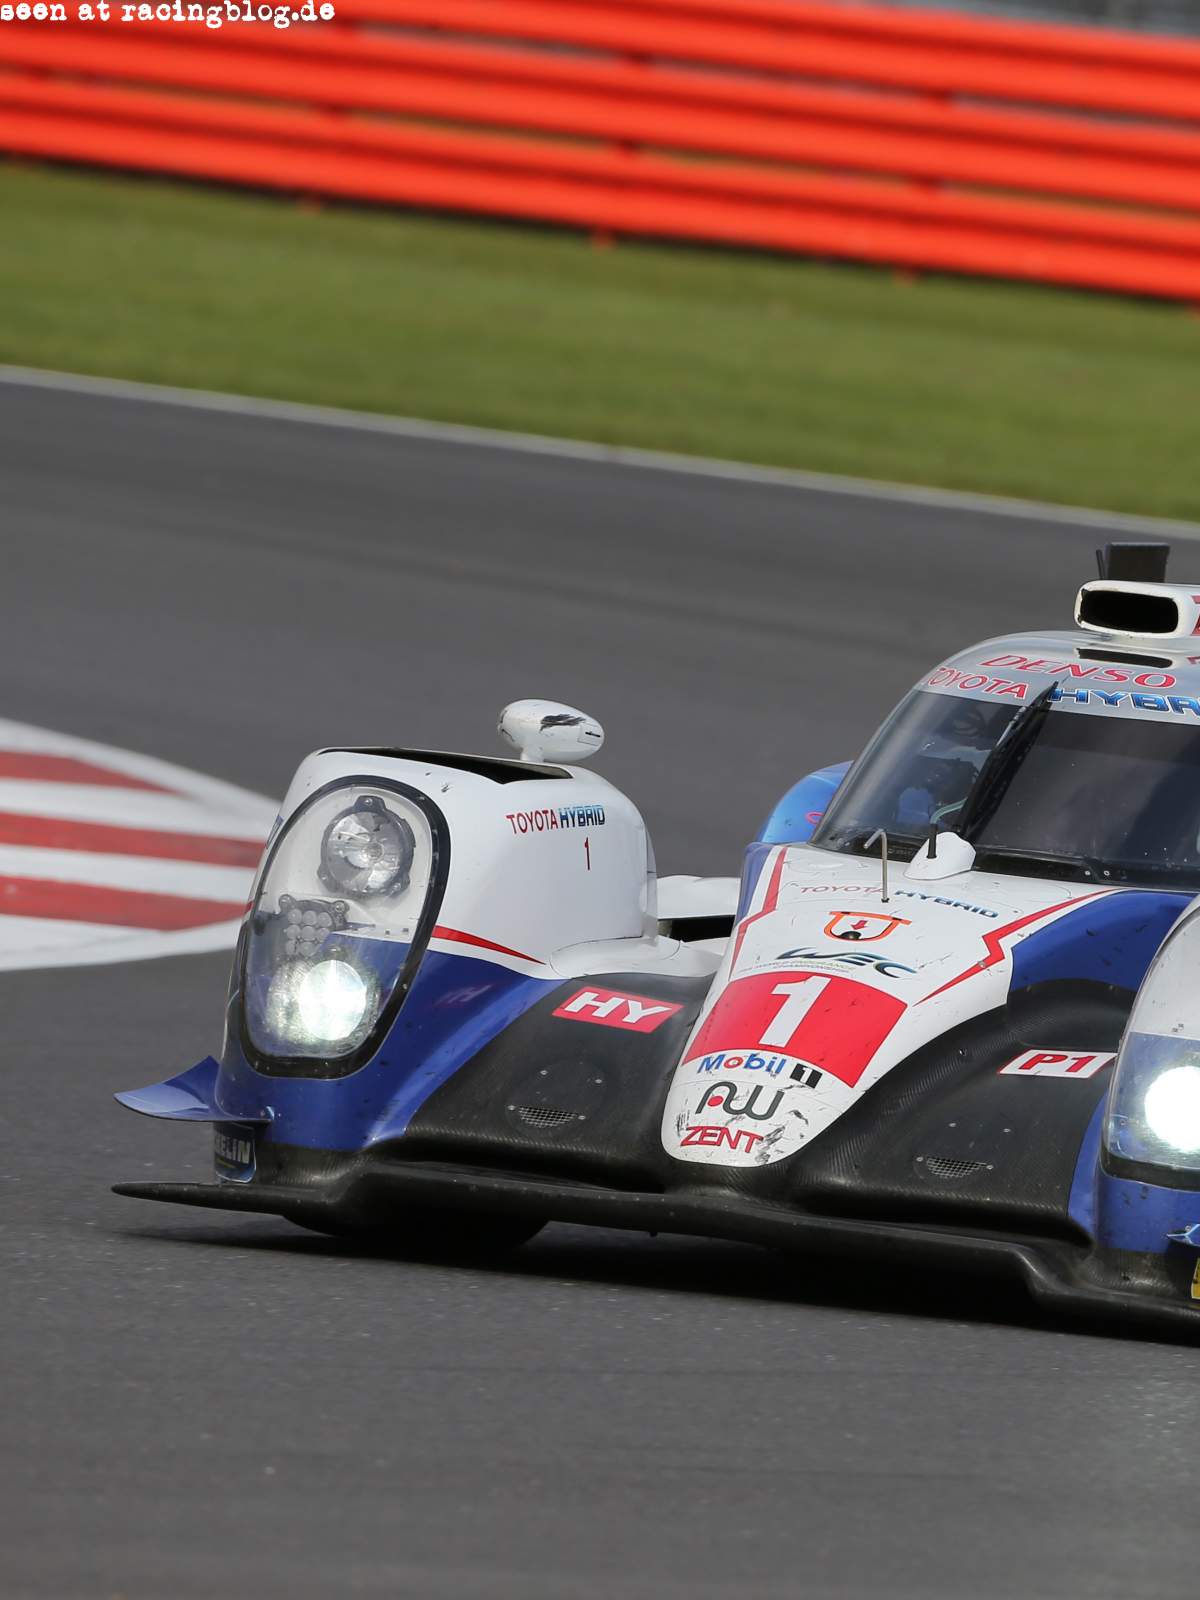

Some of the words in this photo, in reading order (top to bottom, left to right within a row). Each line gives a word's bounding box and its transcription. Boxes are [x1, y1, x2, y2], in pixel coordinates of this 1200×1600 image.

[926, 667, 1029, 699] TOYOTA
[980, 655, 1176, 688] DENSO
[506, 809, 558, 834] TOYOTA
[559, 805, 605, 829] HYBRID
[584, 837, 590, 871] 1
[800, 886, 885, 894] TOYOTA
[895, 890, 999, 918] HYBRID
[564, 991, 672, 1024] HY
[758, 975, 832, 1048] 1
[697, 1053, 786, 1074] Mobil
[1018, 1053, 1098, 1073] P1
[680, 1126, 764, 1153] ZENT
